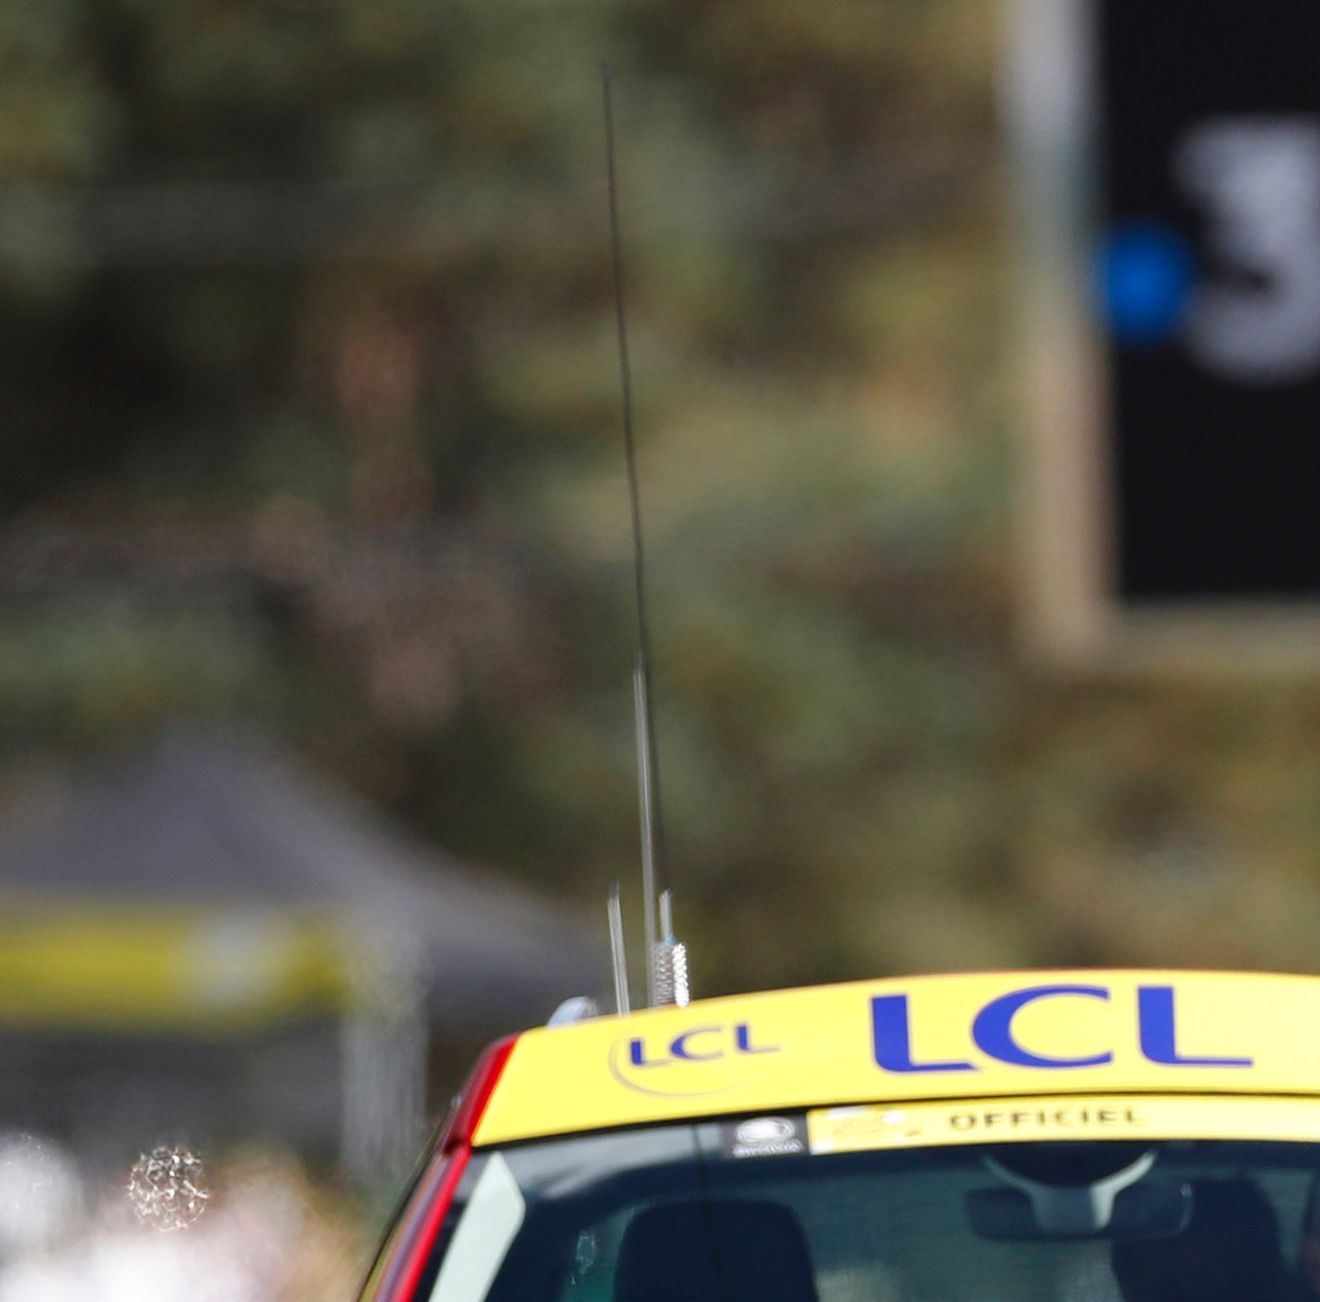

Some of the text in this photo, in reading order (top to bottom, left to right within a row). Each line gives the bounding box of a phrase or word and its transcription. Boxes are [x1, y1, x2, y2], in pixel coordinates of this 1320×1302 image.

[629, 1023, 781, 1067] LCL
[870, 985, 1254, 1074] LCL
[949, 1107, 1146, 1133] OFFICIEL
